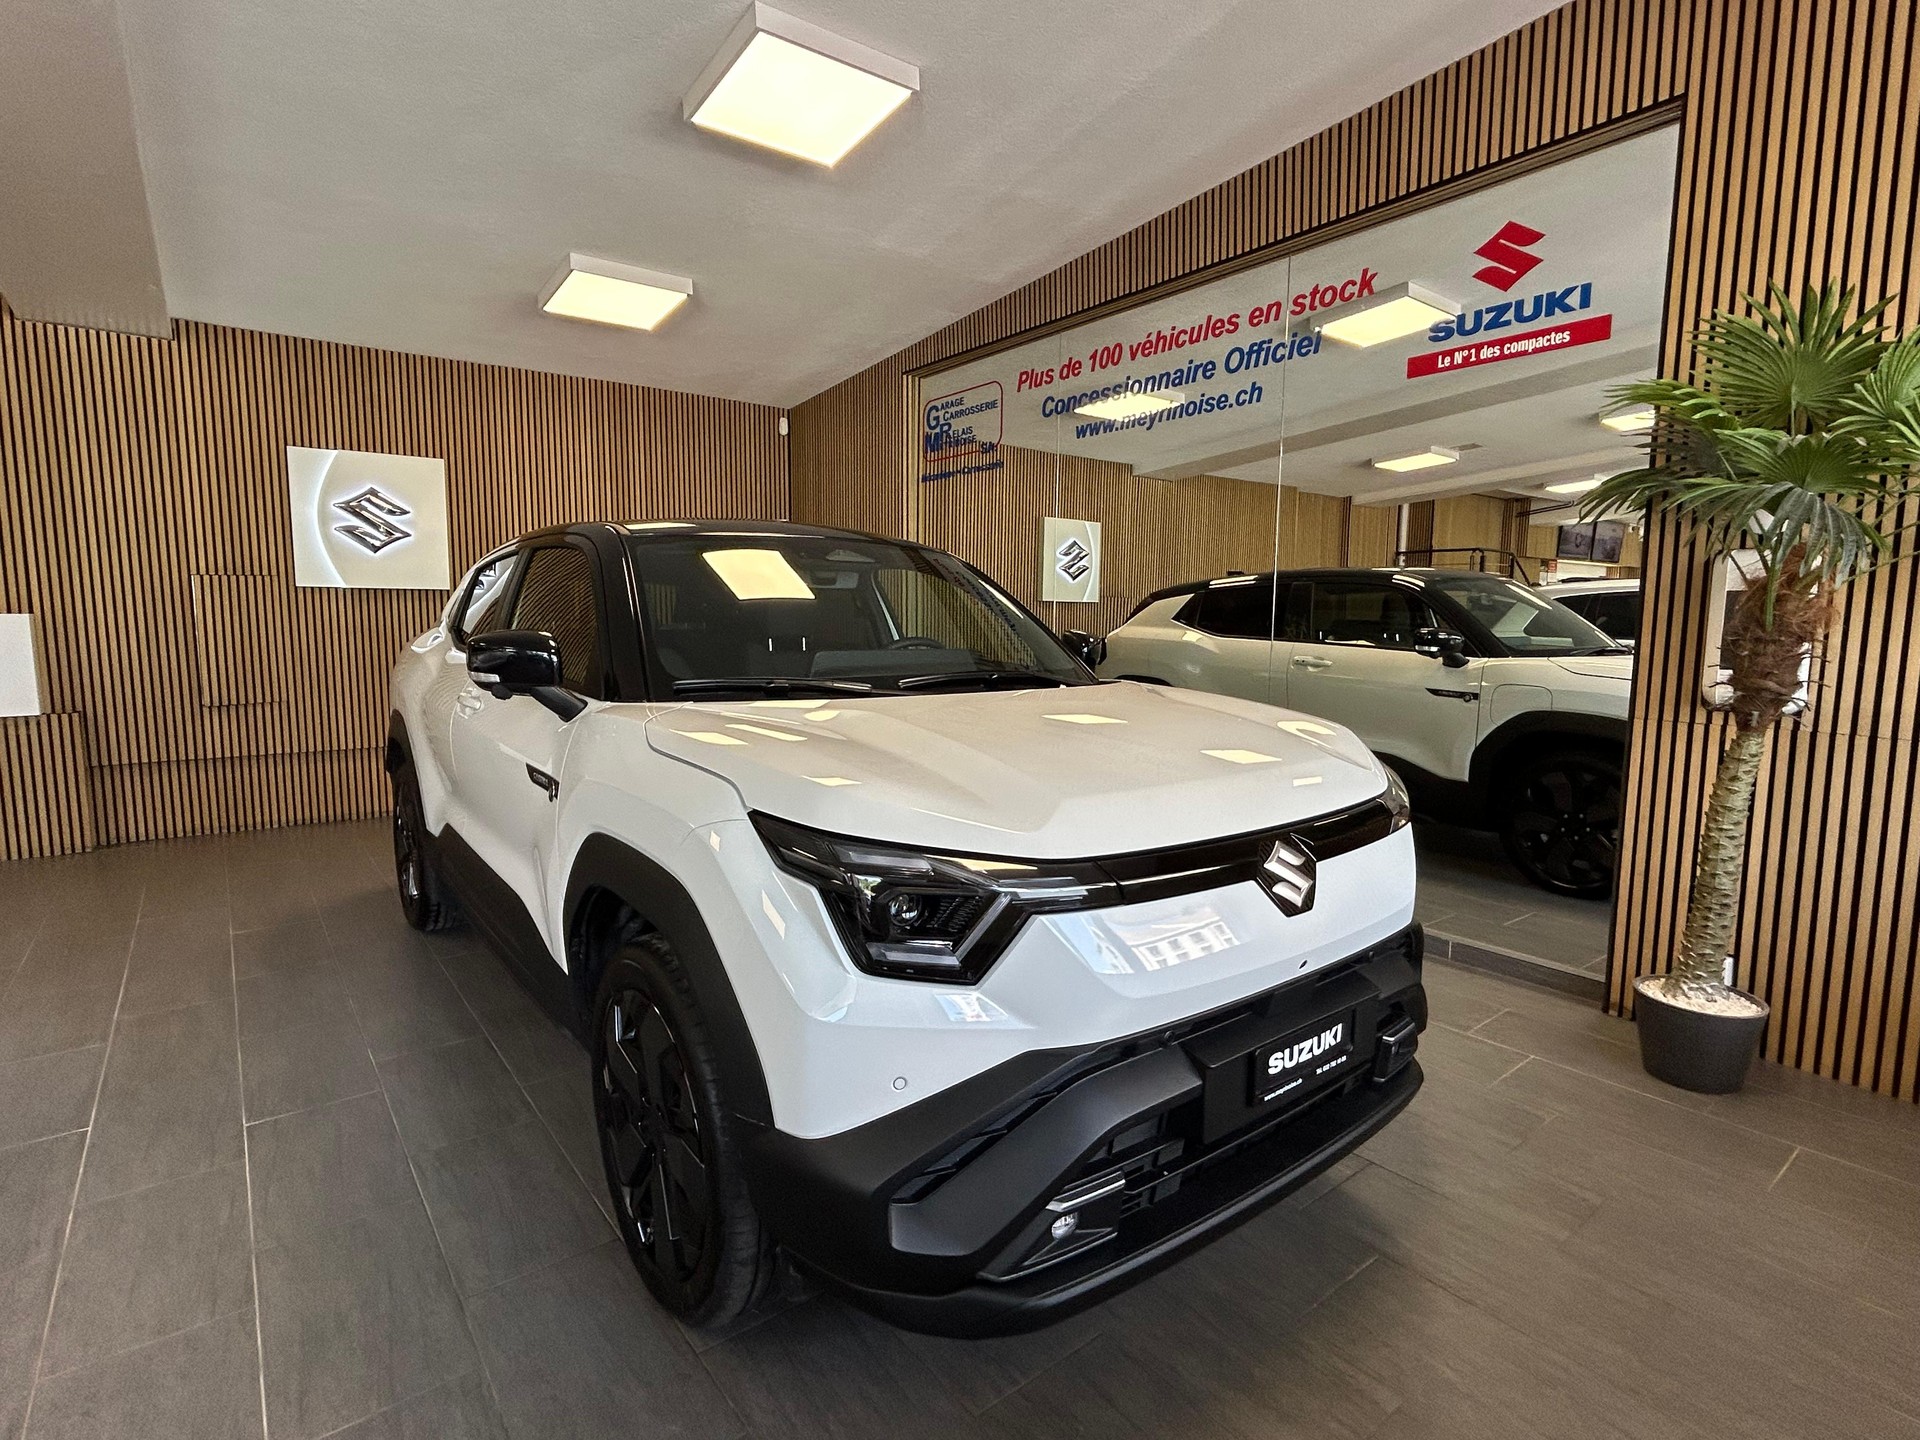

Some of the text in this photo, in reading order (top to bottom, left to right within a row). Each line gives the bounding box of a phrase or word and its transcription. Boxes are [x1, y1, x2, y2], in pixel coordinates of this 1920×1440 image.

[1017, 267, 1378, 392] Plus de 100 véhicules en stock
[1428, 282, 1592, 342] SUZUKI
[1042, 330, 1322, 418] Concessionnaire Officiel
[1437, 355, 1450, 368] Le
[1480, 344, 1500, 359] des
[1504, 330, 1571, 354] compactes
[943, 399, 999, 422] CARROSSERIE
[1268, 1023, 1343, 1074] SUZUKI
